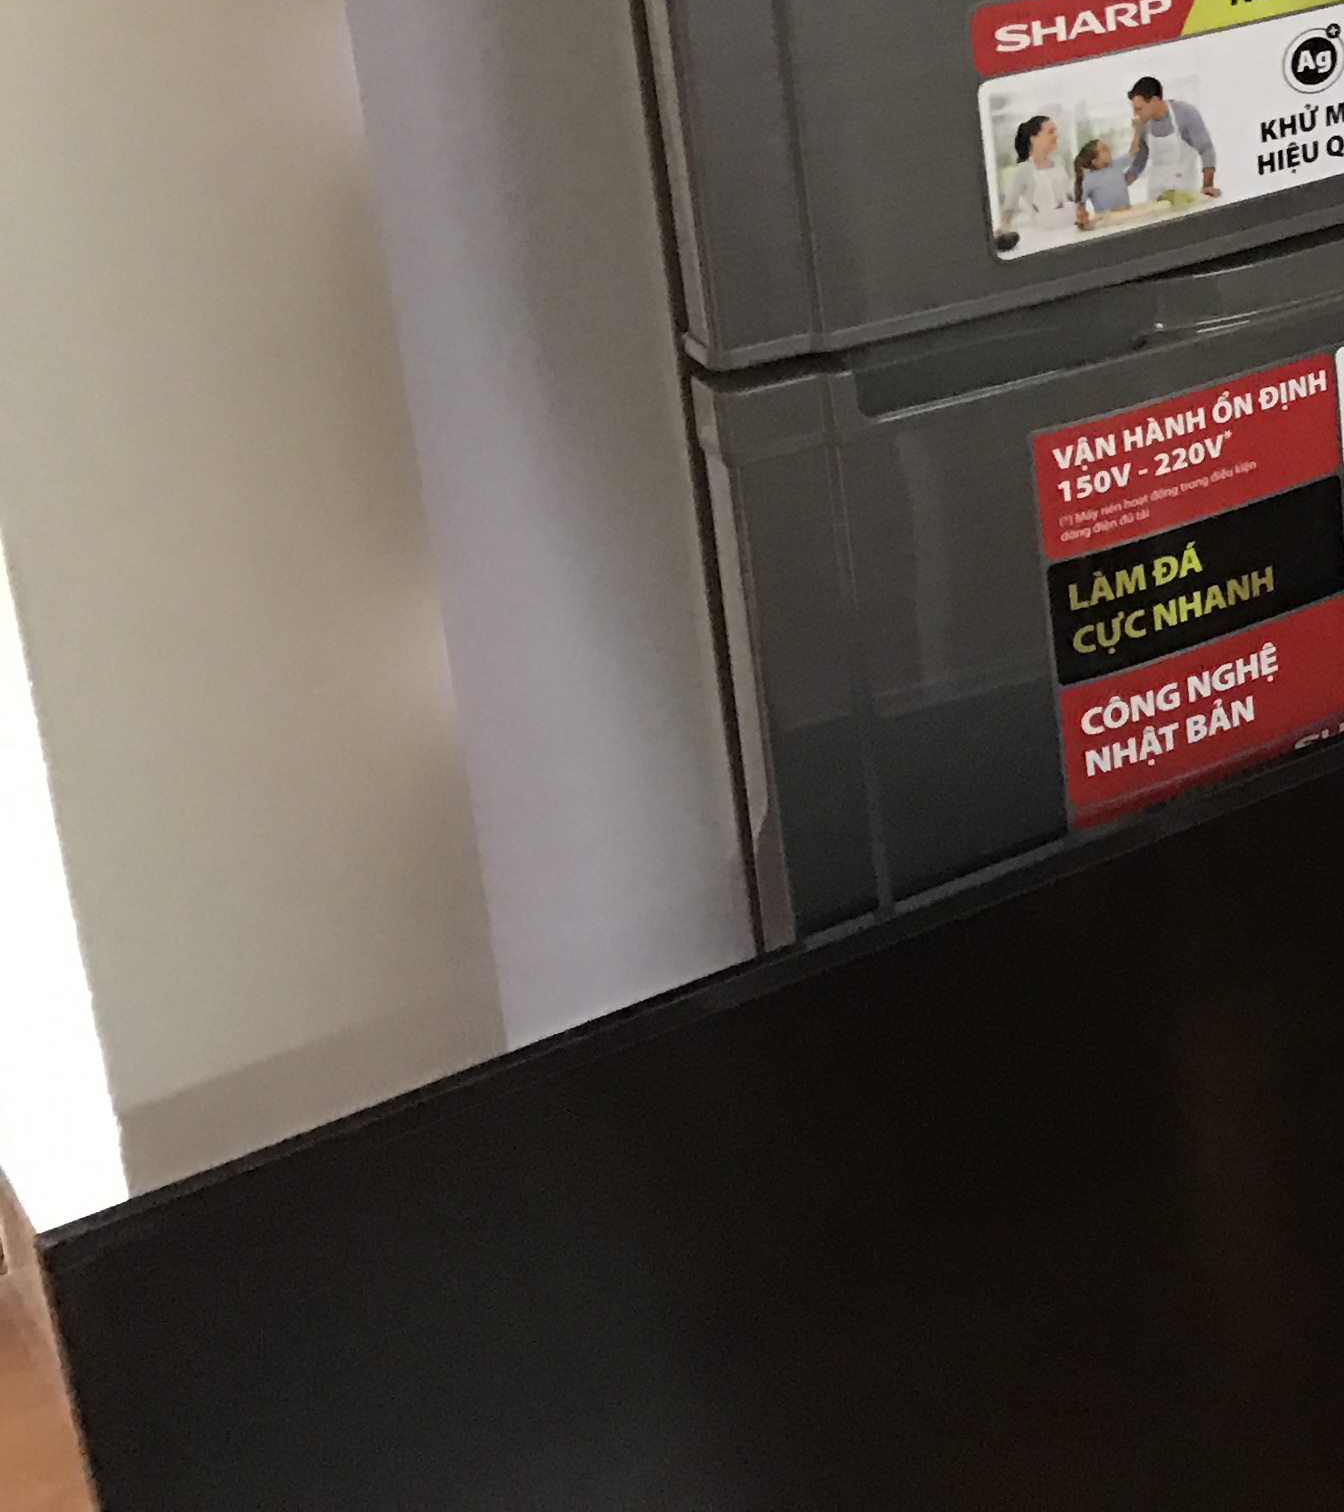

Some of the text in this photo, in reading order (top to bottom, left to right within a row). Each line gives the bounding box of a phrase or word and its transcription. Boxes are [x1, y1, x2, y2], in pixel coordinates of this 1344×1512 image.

[1257, 142, 1319, 176] HIỆU
[1260, 103, 1319, 144] KHỬ
[1052, 433, 1117, 472] VẬN
[1123, 406, 1206, 452] HÀNH
[1258, 370, 1327, 411] ĐỊNH
[1057, 463, 1132, 503] 150V
[1068, 541, 1203, 611] LÀM ĐÁ
[1072, 565, 1275, 655] CỰC NHANH
[1081, 642, 1279, 736] CÔNG NGHỆ
[1084, 695, 1255, 777] NHẬT BẢN
